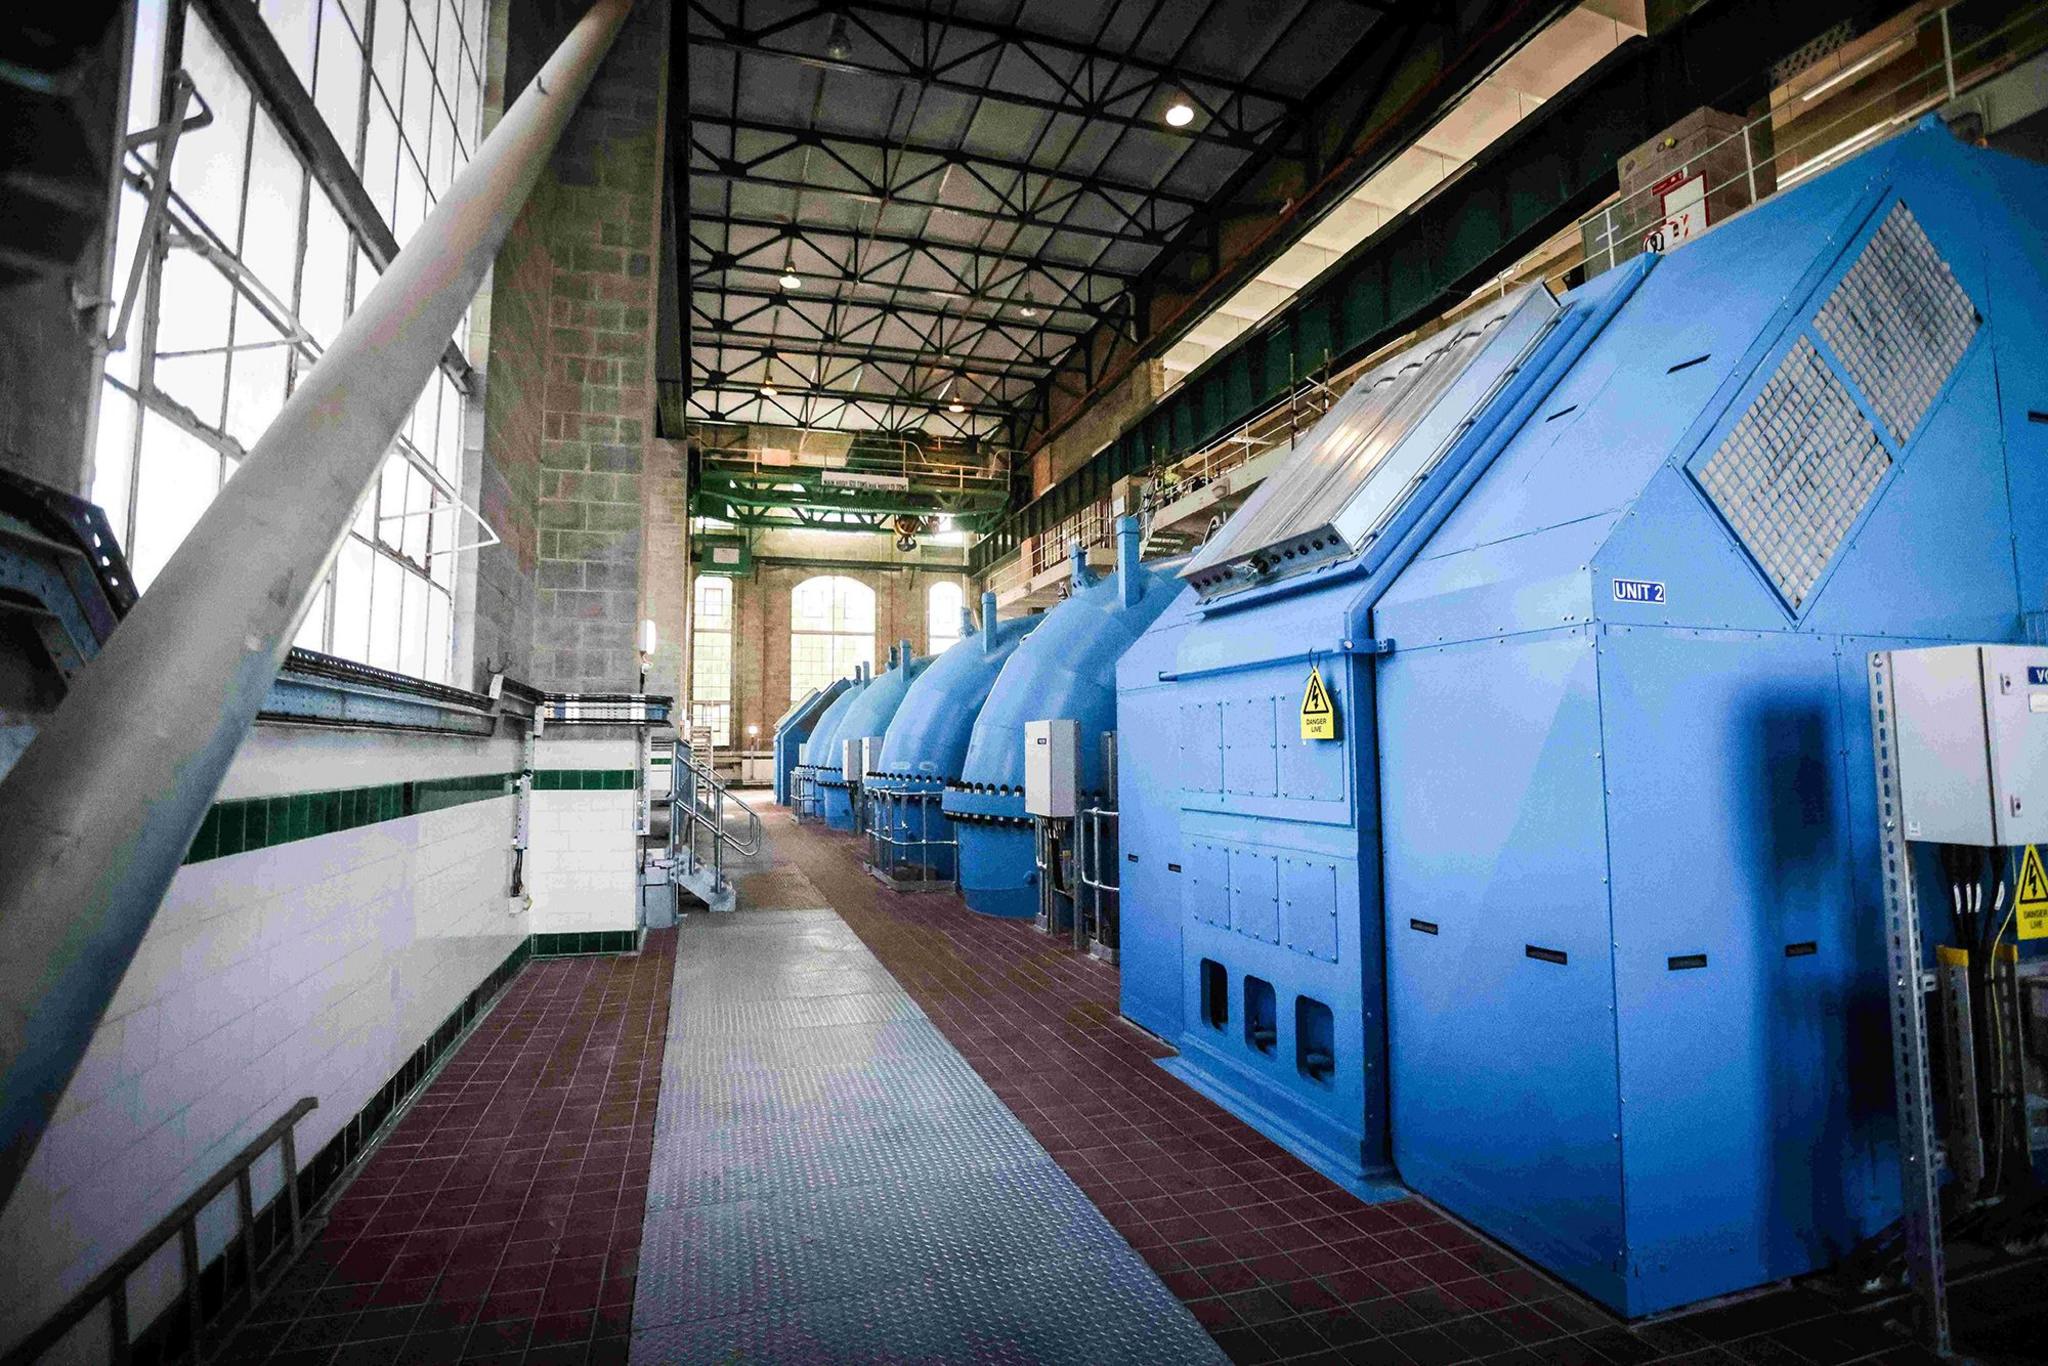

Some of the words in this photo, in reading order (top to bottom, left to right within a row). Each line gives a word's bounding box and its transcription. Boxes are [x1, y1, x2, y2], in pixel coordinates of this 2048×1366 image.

[1615, 582, 1650, 600] UNIT
[1655, 585, 1663, 601] 2
[1306, 718, 1327, 726] DANGER
